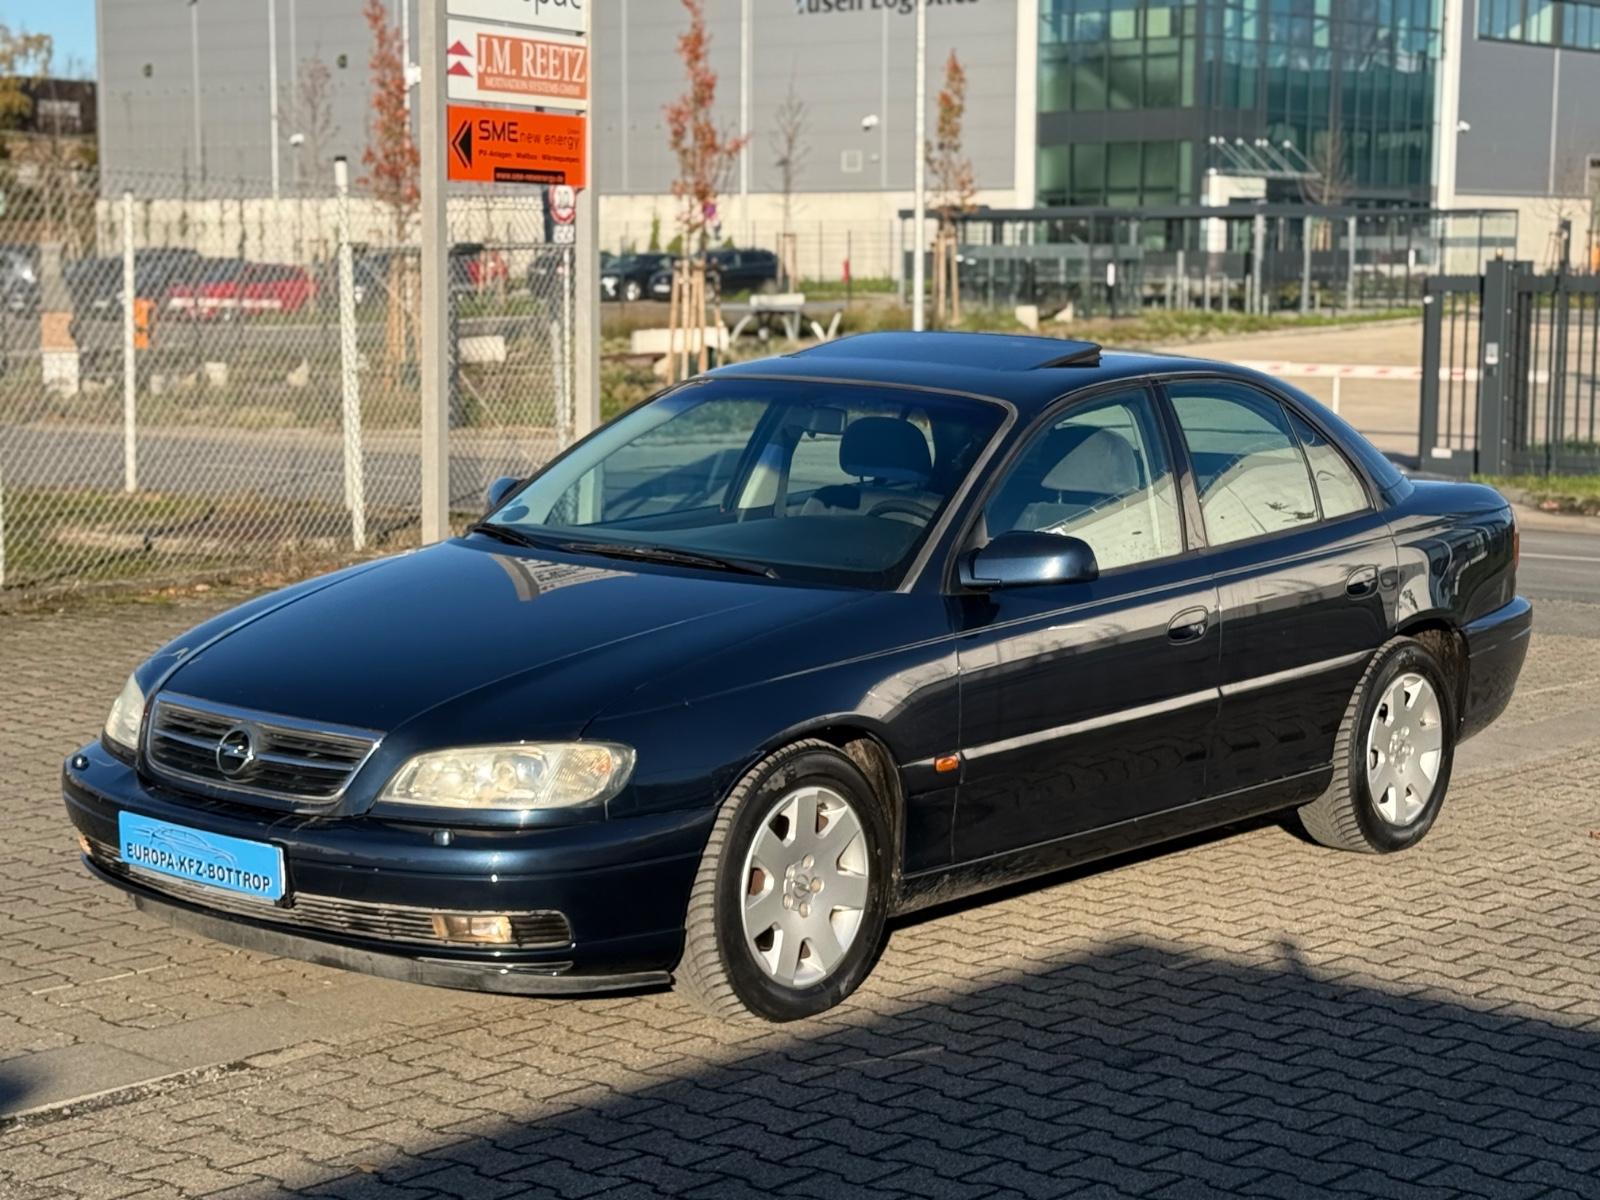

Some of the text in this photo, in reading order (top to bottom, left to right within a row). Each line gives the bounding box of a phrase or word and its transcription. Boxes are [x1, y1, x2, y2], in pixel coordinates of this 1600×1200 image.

[477, 36, 586, 83] J.M. REETZ
[478, 119, 580, 150] SME new energy
